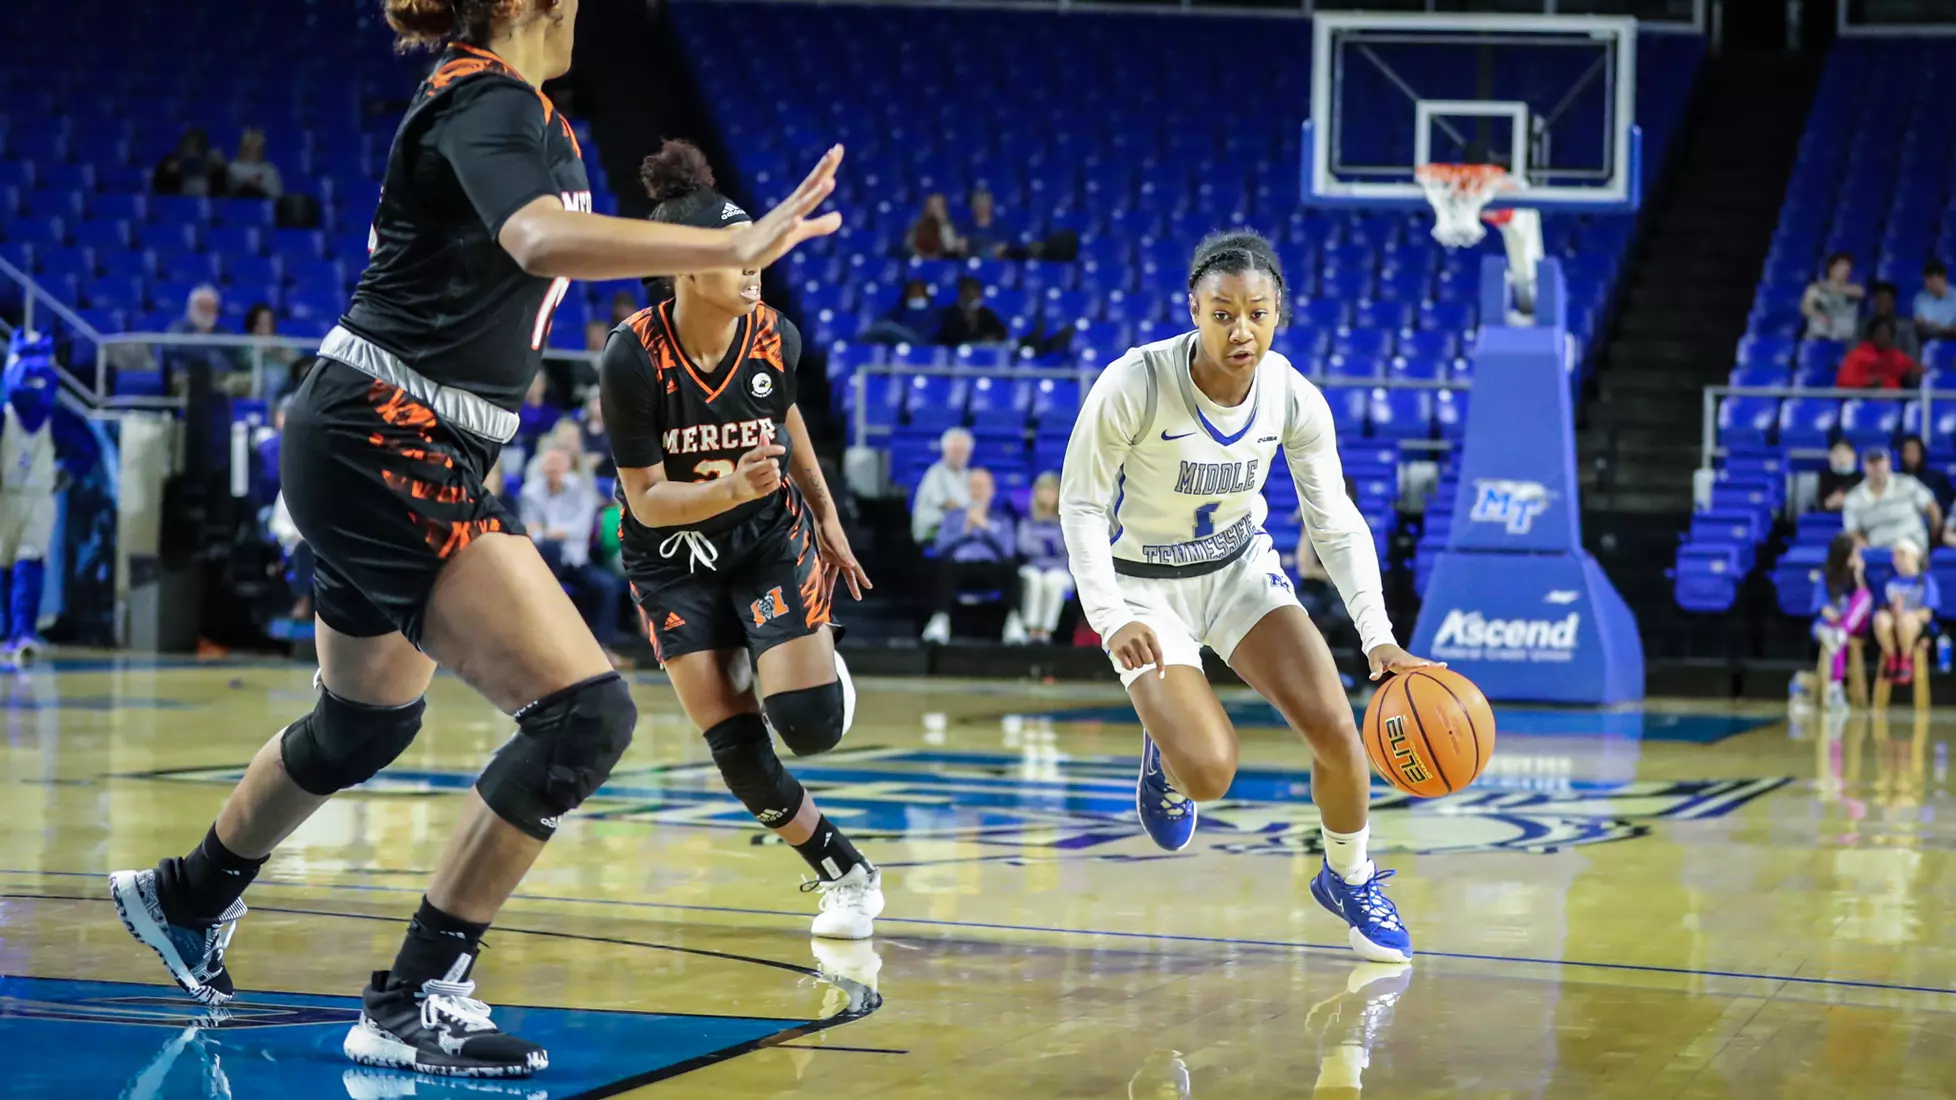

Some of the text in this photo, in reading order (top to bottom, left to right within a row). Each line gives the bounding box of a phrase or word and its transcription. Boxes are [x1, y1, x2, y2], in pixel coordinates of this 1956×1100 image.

[662, 416, 776, 455] MERCER
[1175, 459, 1259, 495] MIDDLE
[1193, 501, 1222, 539] 1
[1470, 478, 1552, 536] MT
[1143, 512, 1257, 564] TENNESSEE
[1433, 609, 1580, 650] Ascend
[1385, 715, 1427, 784] ELITE
